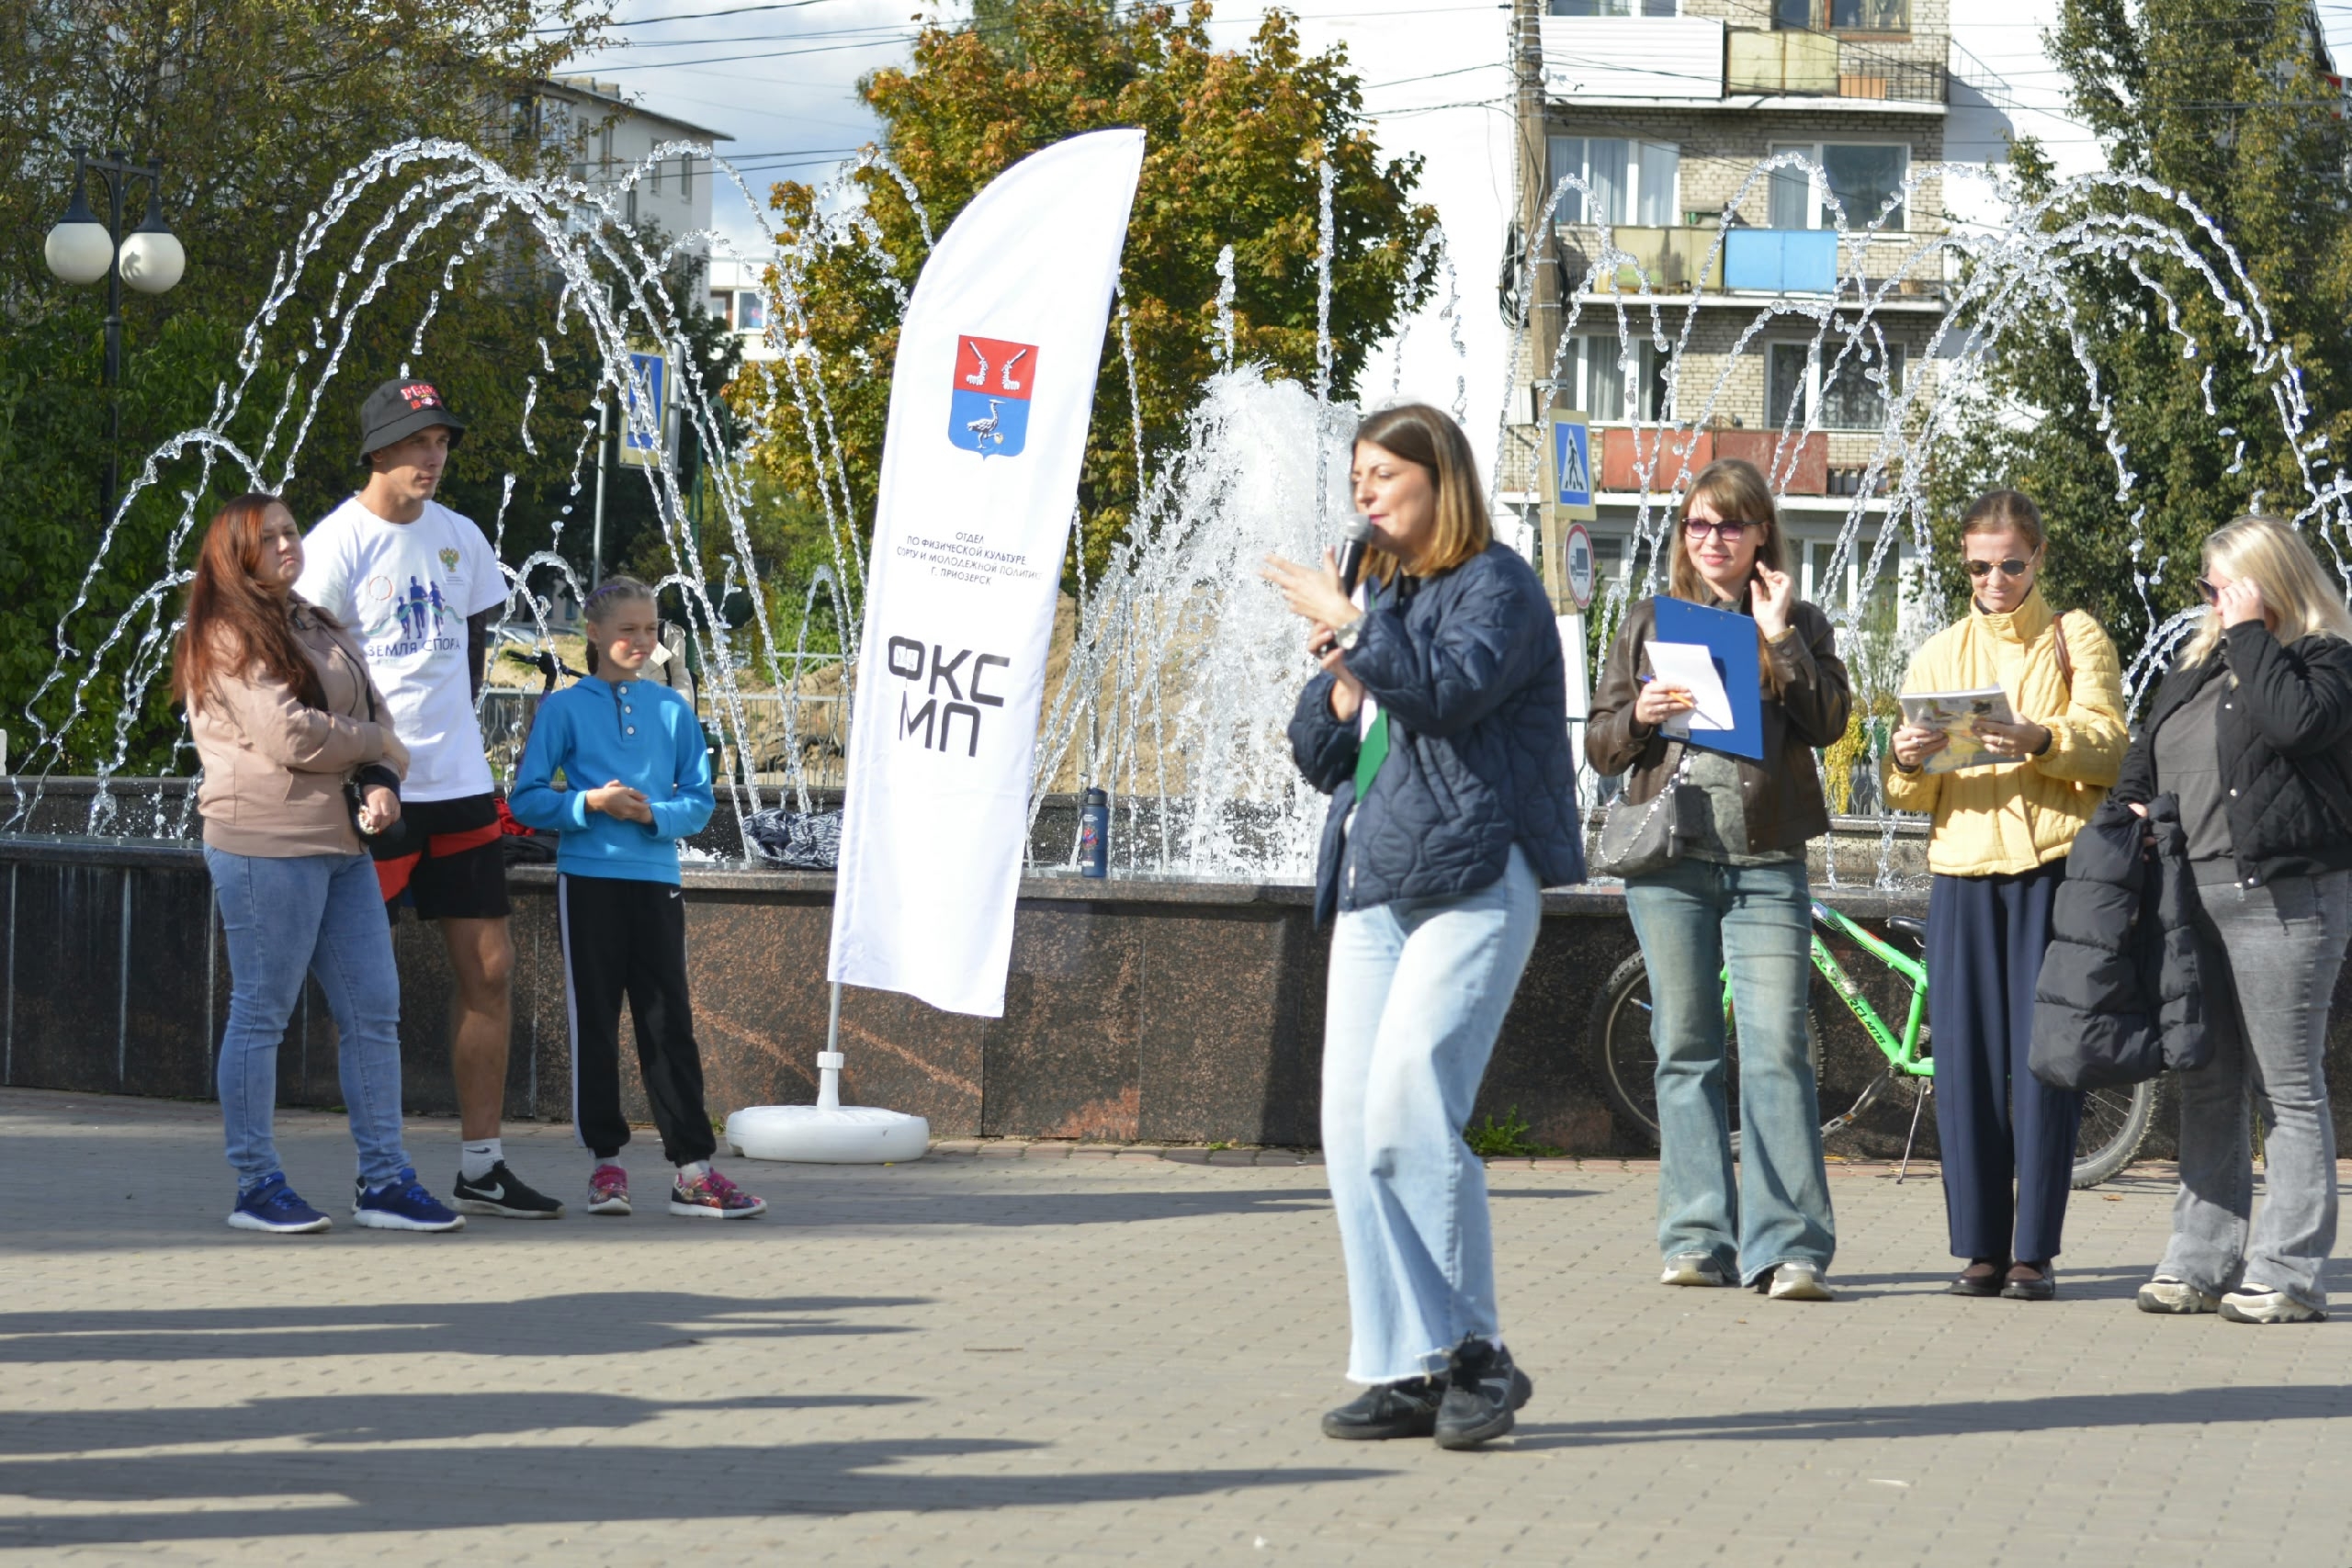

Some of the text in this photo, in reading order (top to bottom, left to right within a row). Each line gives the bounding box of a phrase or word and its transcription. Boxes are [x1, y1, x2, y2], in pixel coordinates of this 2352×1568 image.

[907, 536, 920, 546] ПО
[922, 539, 983, 557] ФИЗИЧЕСКОЙ
[956, 532, 984, 544] ОТДЕЛ
[921, 552, 927, 560] И
[929, 554, 997, 573] МОЛОДЕЖНОЙ
[941, 568, 991, 586] ПРИОЗЕРСК
[368, 642, 418, 658] ЗЕМЛЯ
[888, 636, 1011, 707] ОКС
[899, 690, 981, 758] МП
